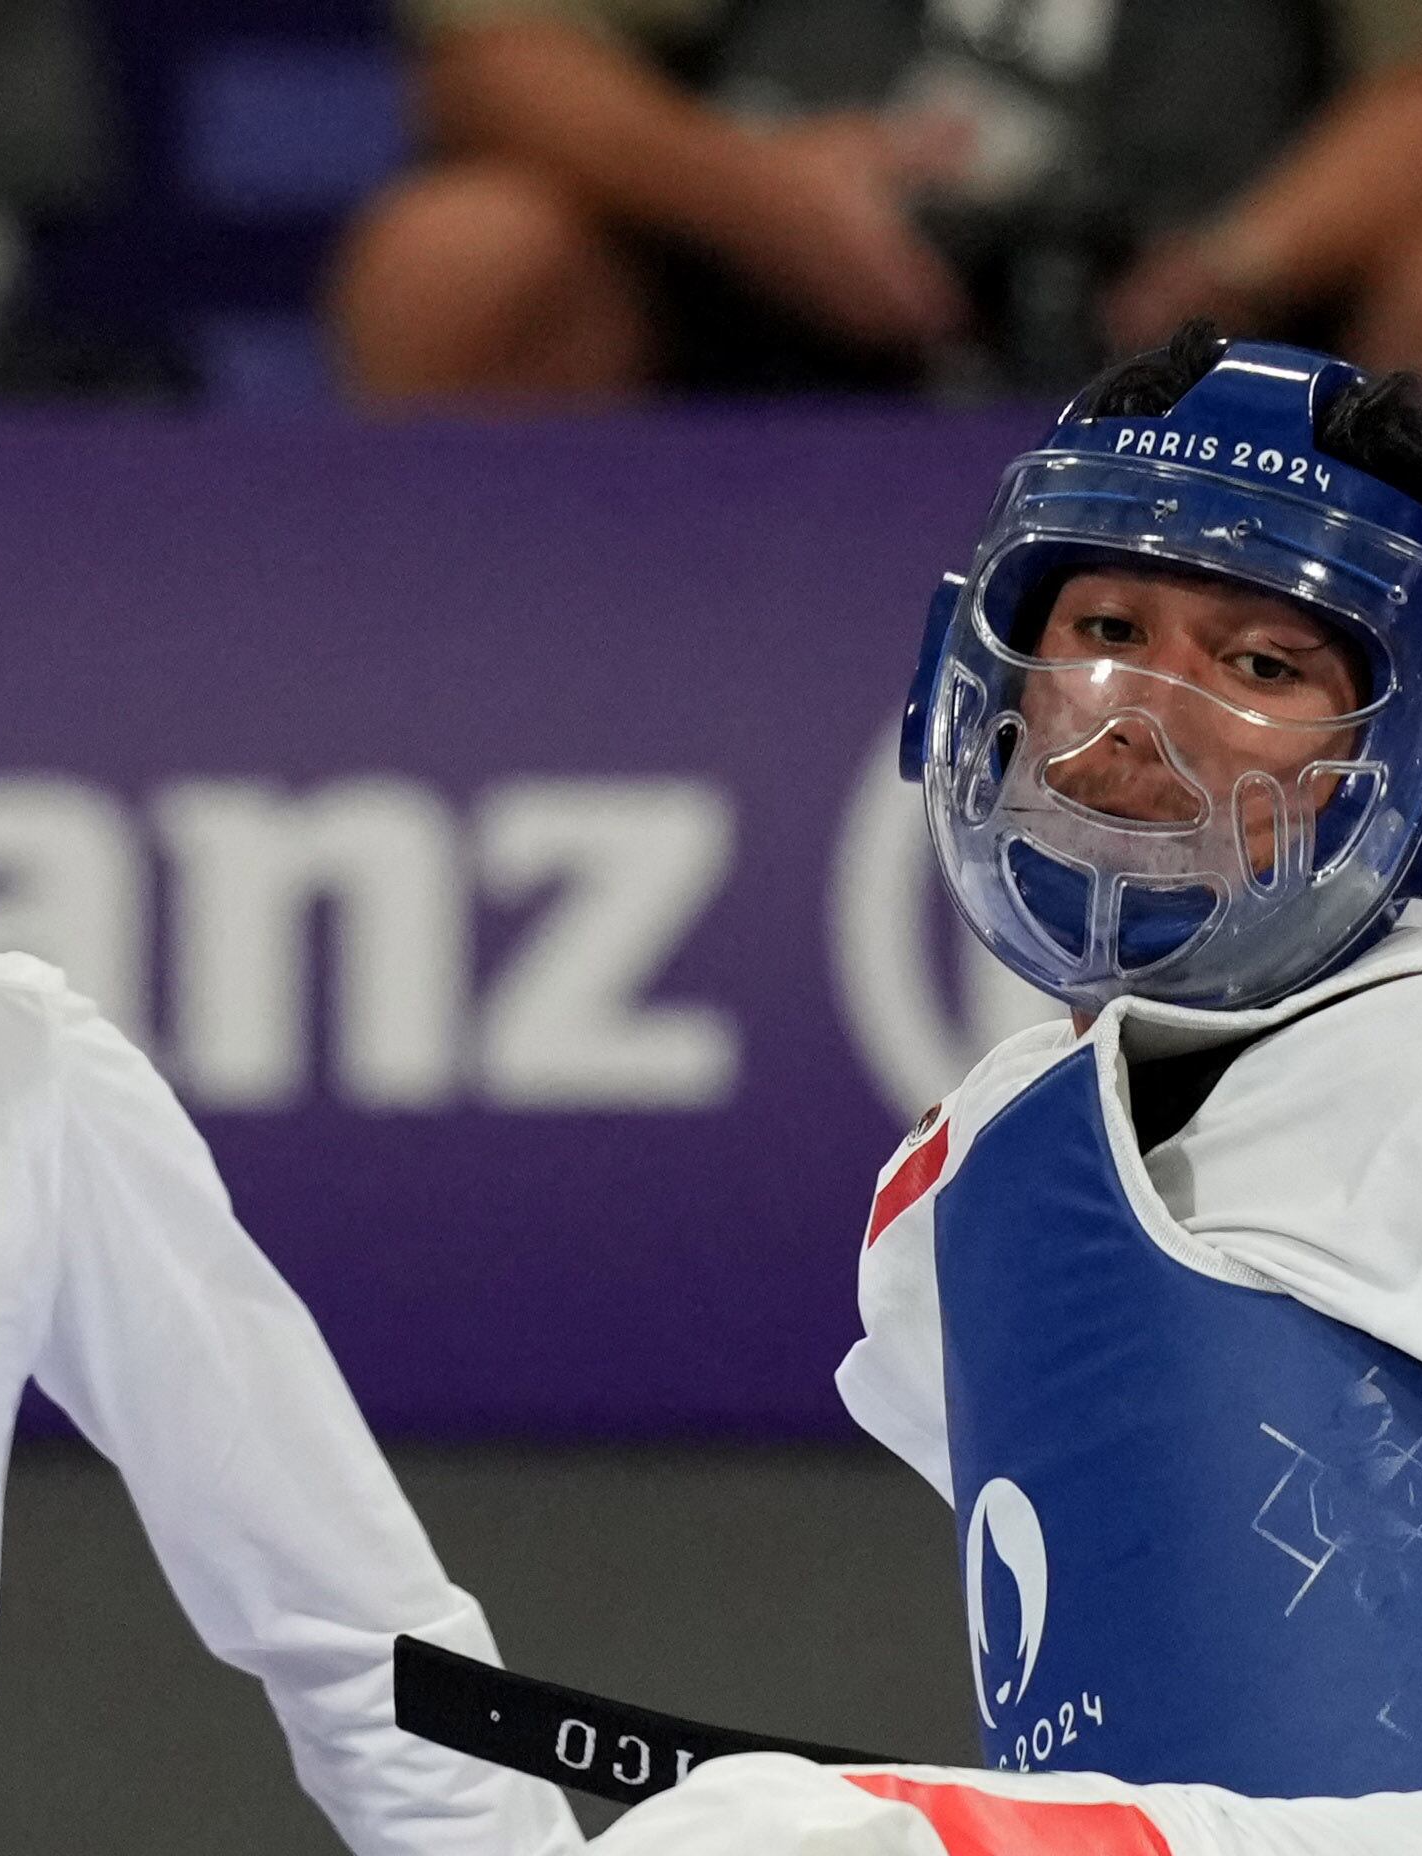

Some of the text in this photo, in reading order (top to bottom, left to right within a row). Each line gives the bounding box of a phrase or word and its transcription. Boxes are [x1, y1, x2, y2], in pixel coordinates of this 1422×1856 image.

[1115, 428, 1332, 493] PARIS 2024
[1015, 1691, 1104, 1773] 2024
